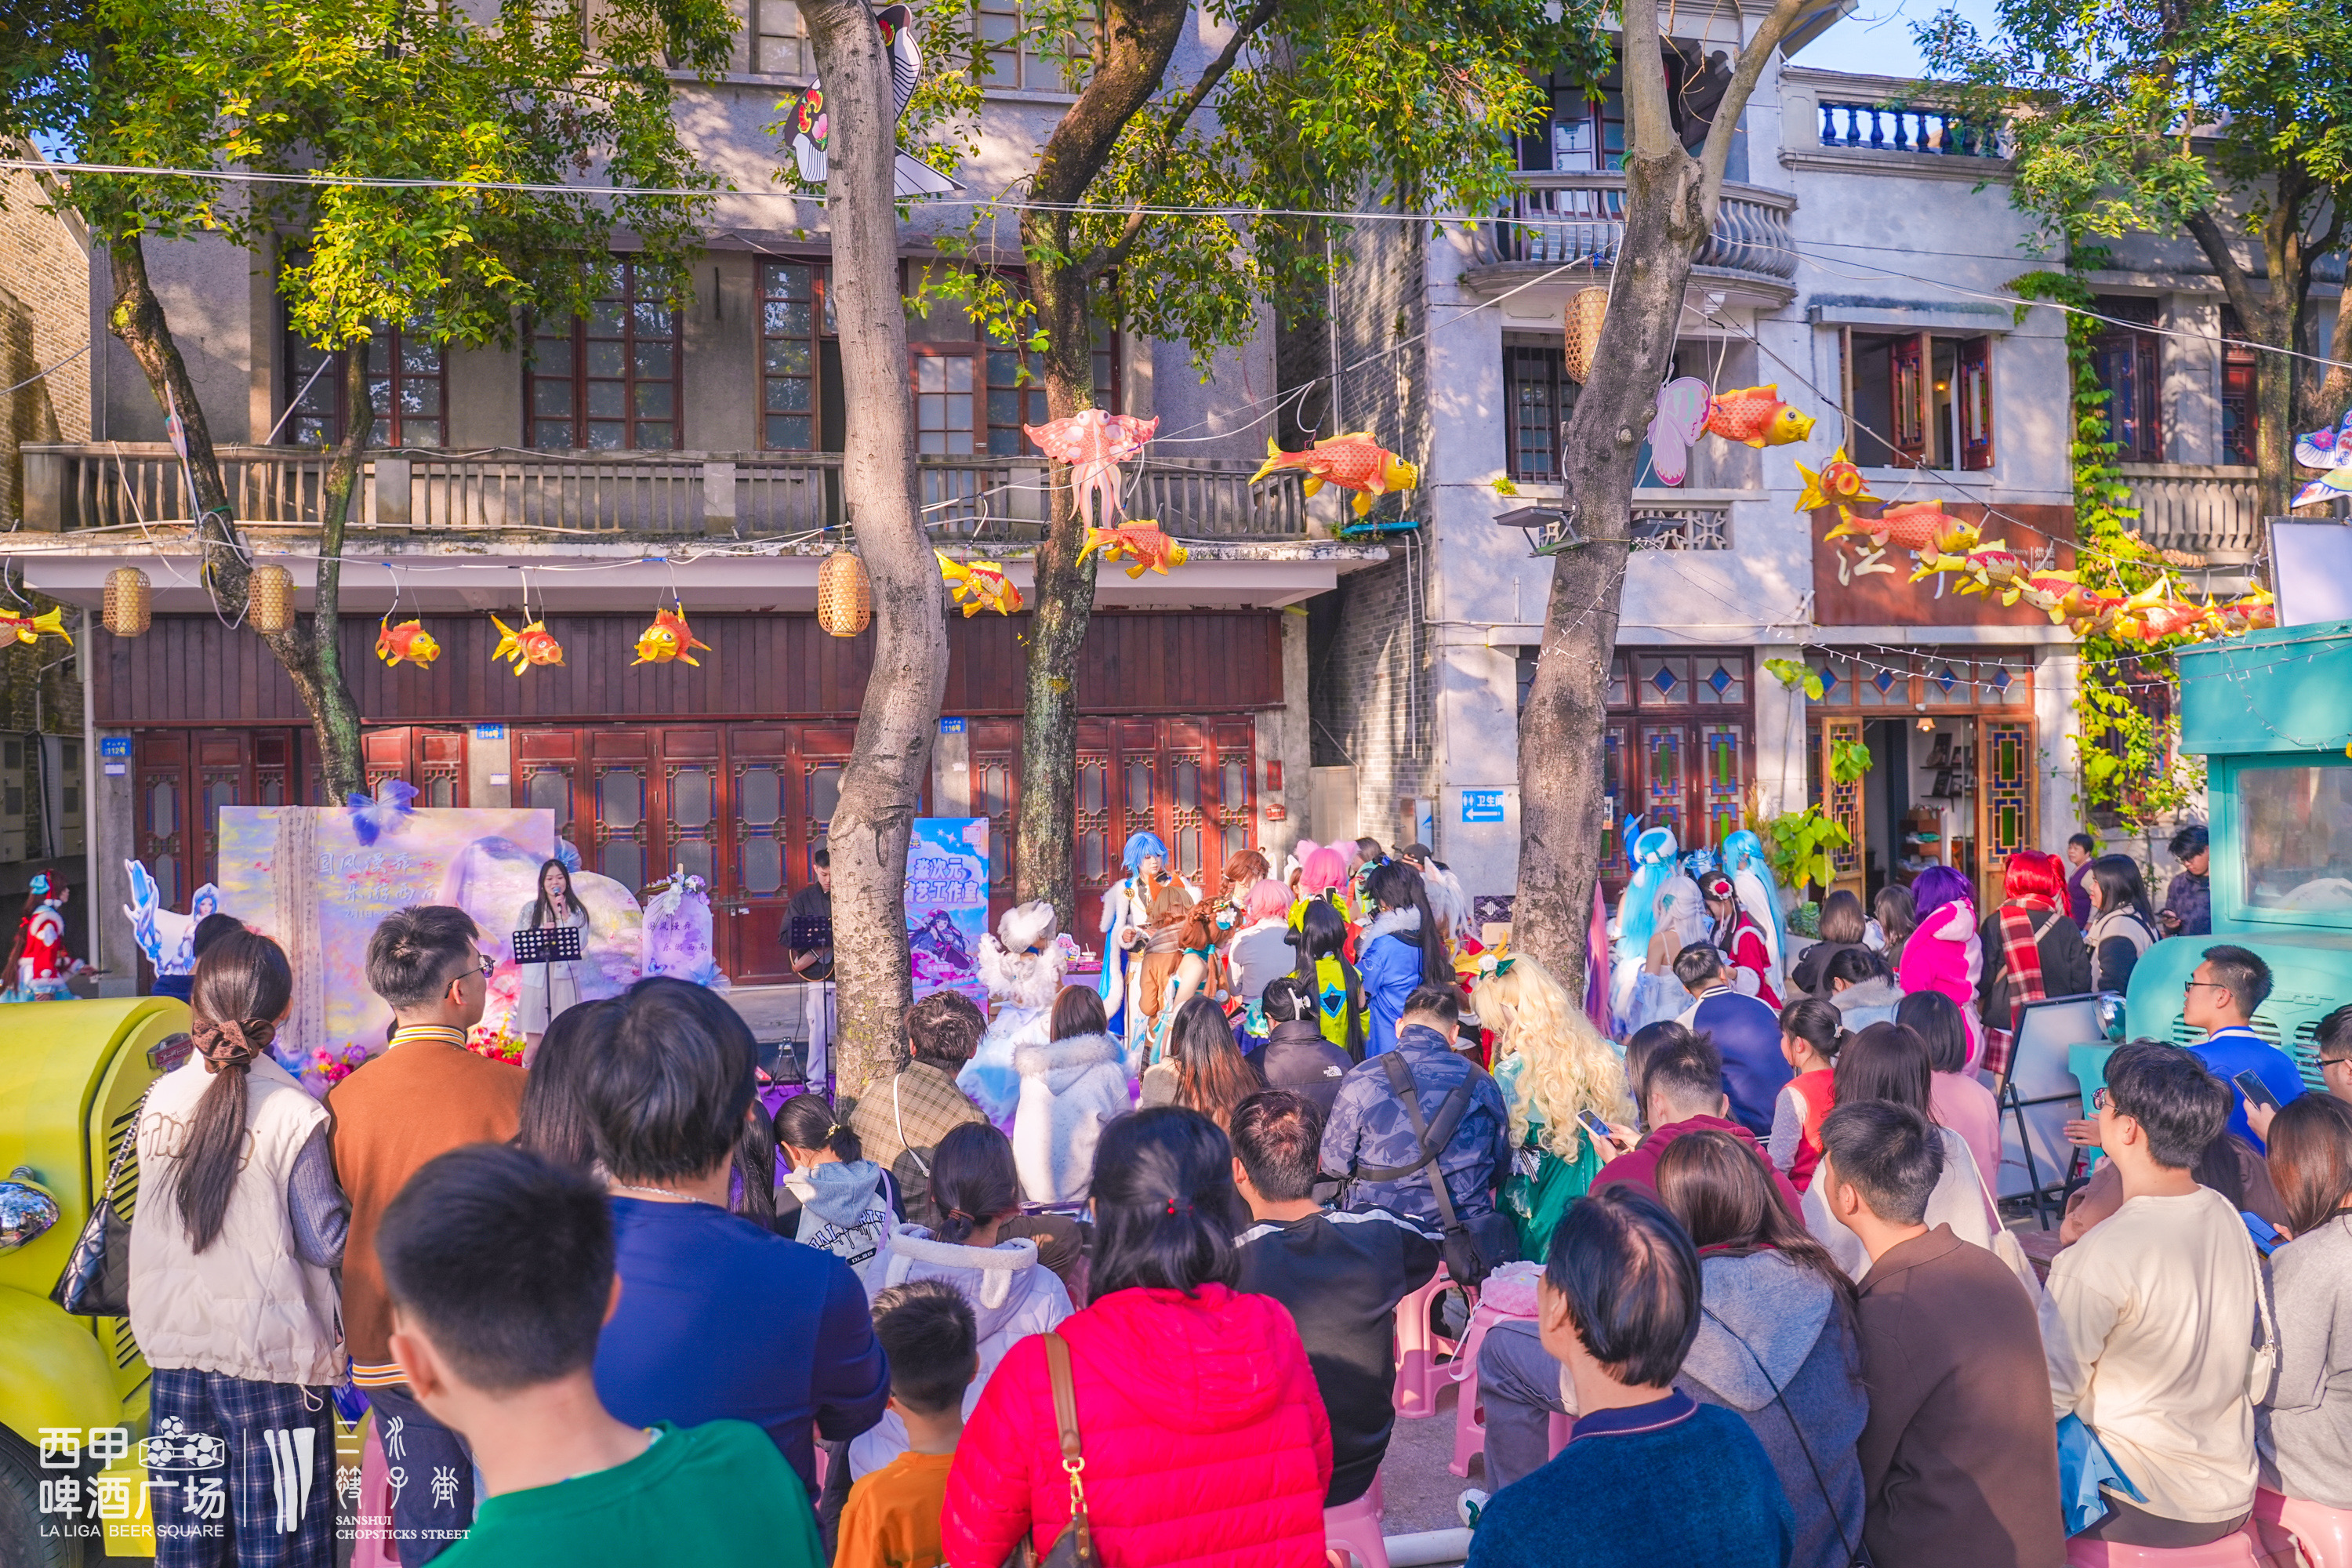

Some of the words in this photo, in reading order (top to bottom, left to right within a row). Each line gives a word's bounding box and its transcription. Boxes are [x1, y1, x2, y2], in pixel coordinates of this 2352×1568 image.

[1476, 794, 1504, 807] 卫生间
[318, 852, 412, 874] 国风漫舞
